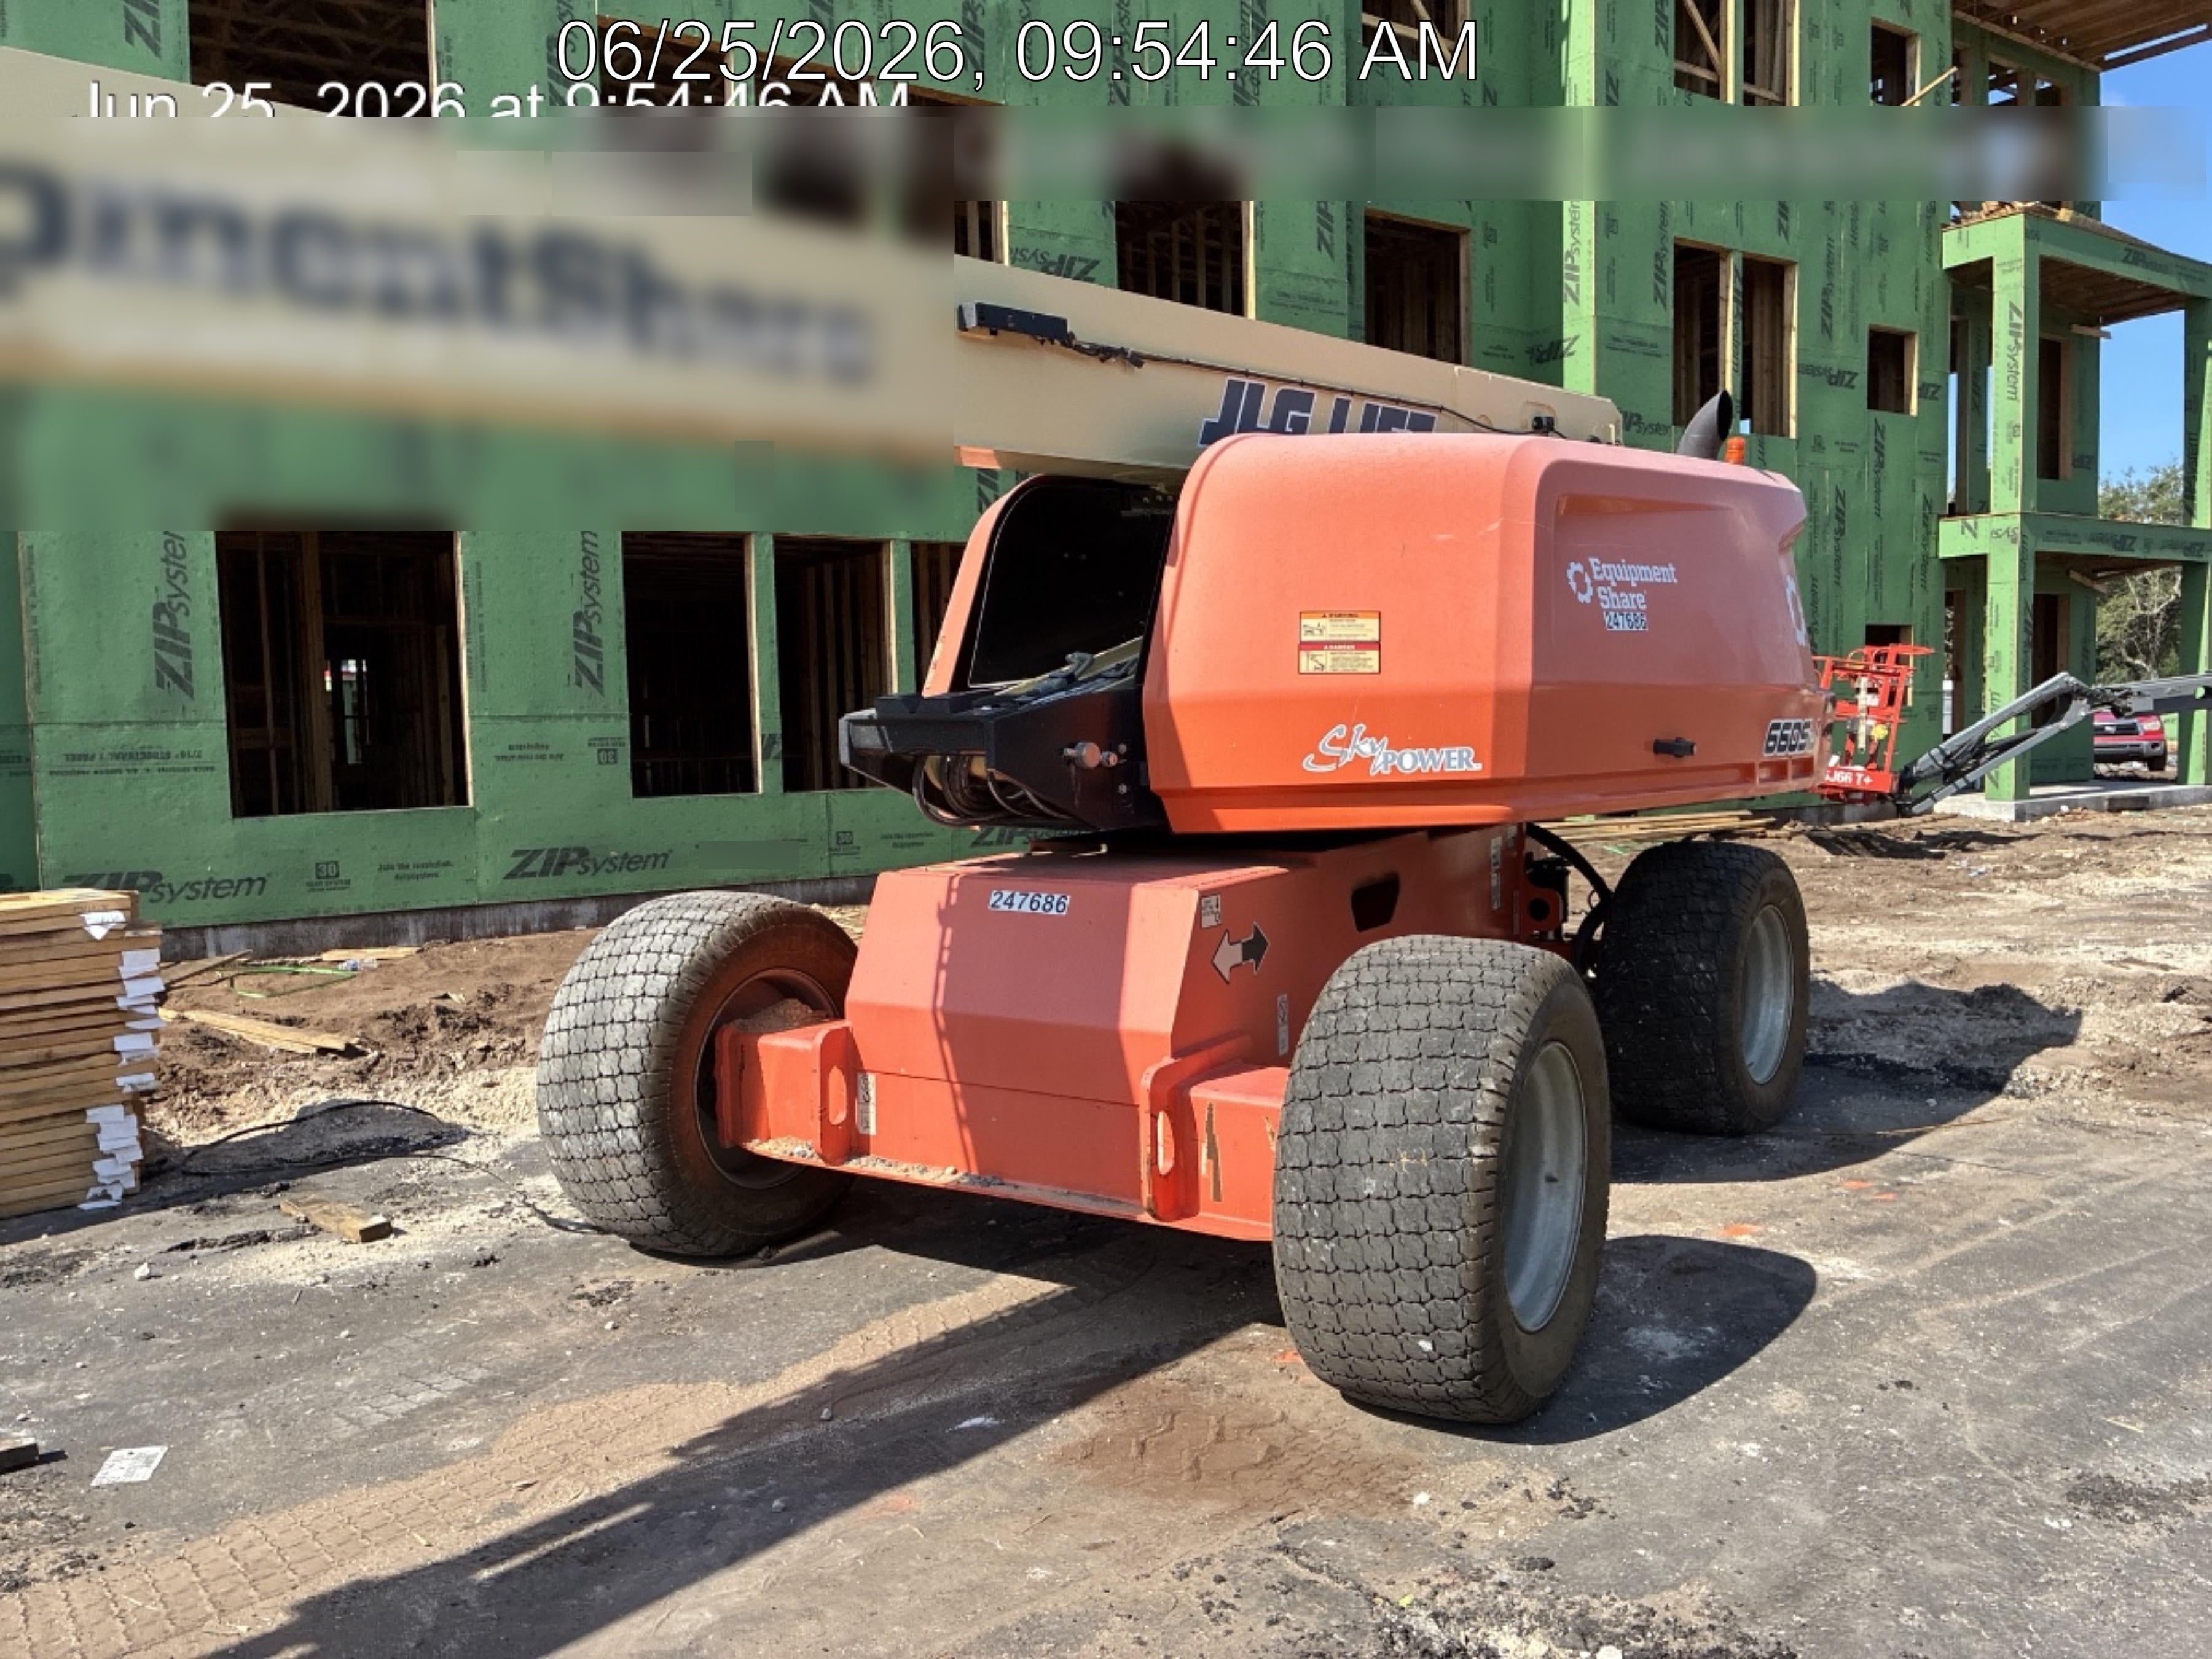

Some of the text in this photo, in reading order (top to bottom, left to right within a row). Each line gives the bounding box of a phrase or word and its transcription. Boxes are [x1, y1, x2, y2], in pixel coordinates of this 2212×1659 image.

[1588, 557, 1679, 587] Equipment
[1597, 586, 1647, 610] Share
[1380, 747, 1475, 774] POWER
[985, 892, 1068, 913] 247686
